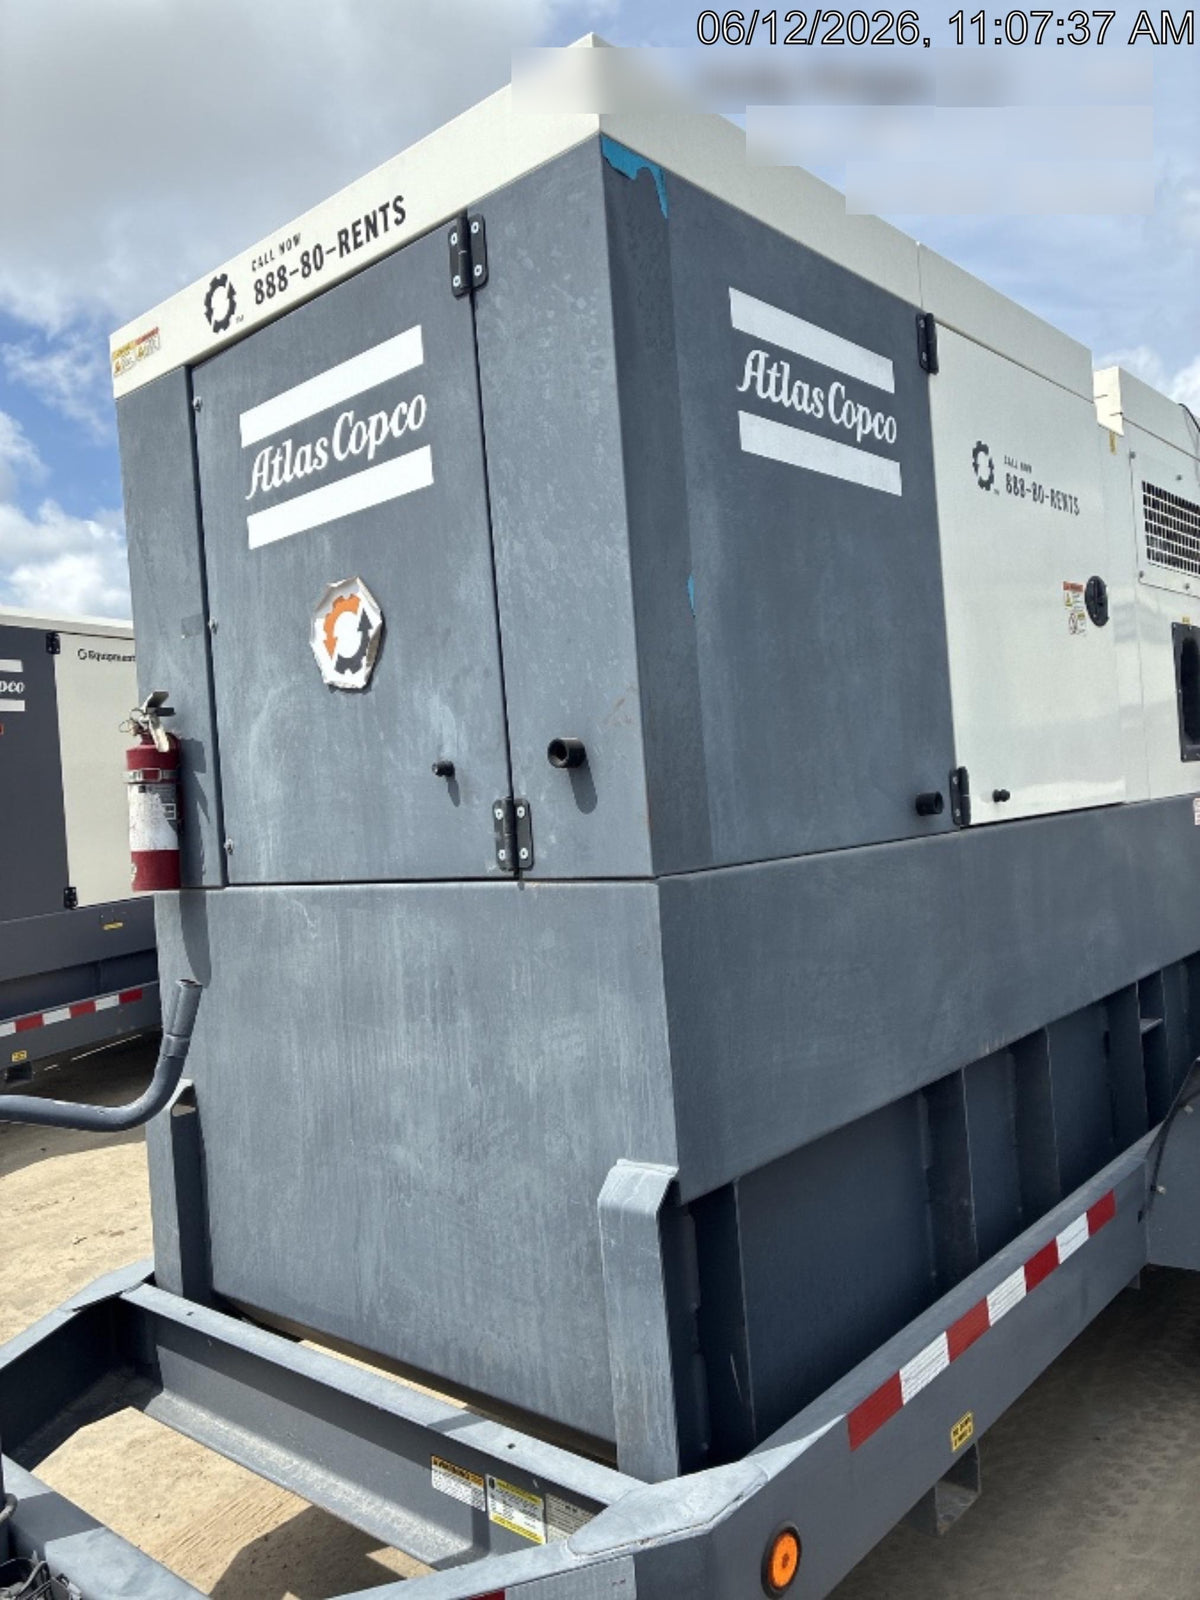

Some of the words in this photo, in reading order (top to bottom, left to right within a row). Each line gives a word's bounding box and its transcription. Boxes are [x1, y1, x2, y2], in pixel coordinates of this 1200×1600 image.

[251, 249, 276, 272] CALL
[279, 232, 302, 256] NOW
[254, 195, 407, 305] 888-80-RENTS
[245, 436, 329, 500] Atlas
[332, 394, 427, 462] Copco
[736, 350, 824, 418] Atlas
[828, 381, 897, 444] Copco
